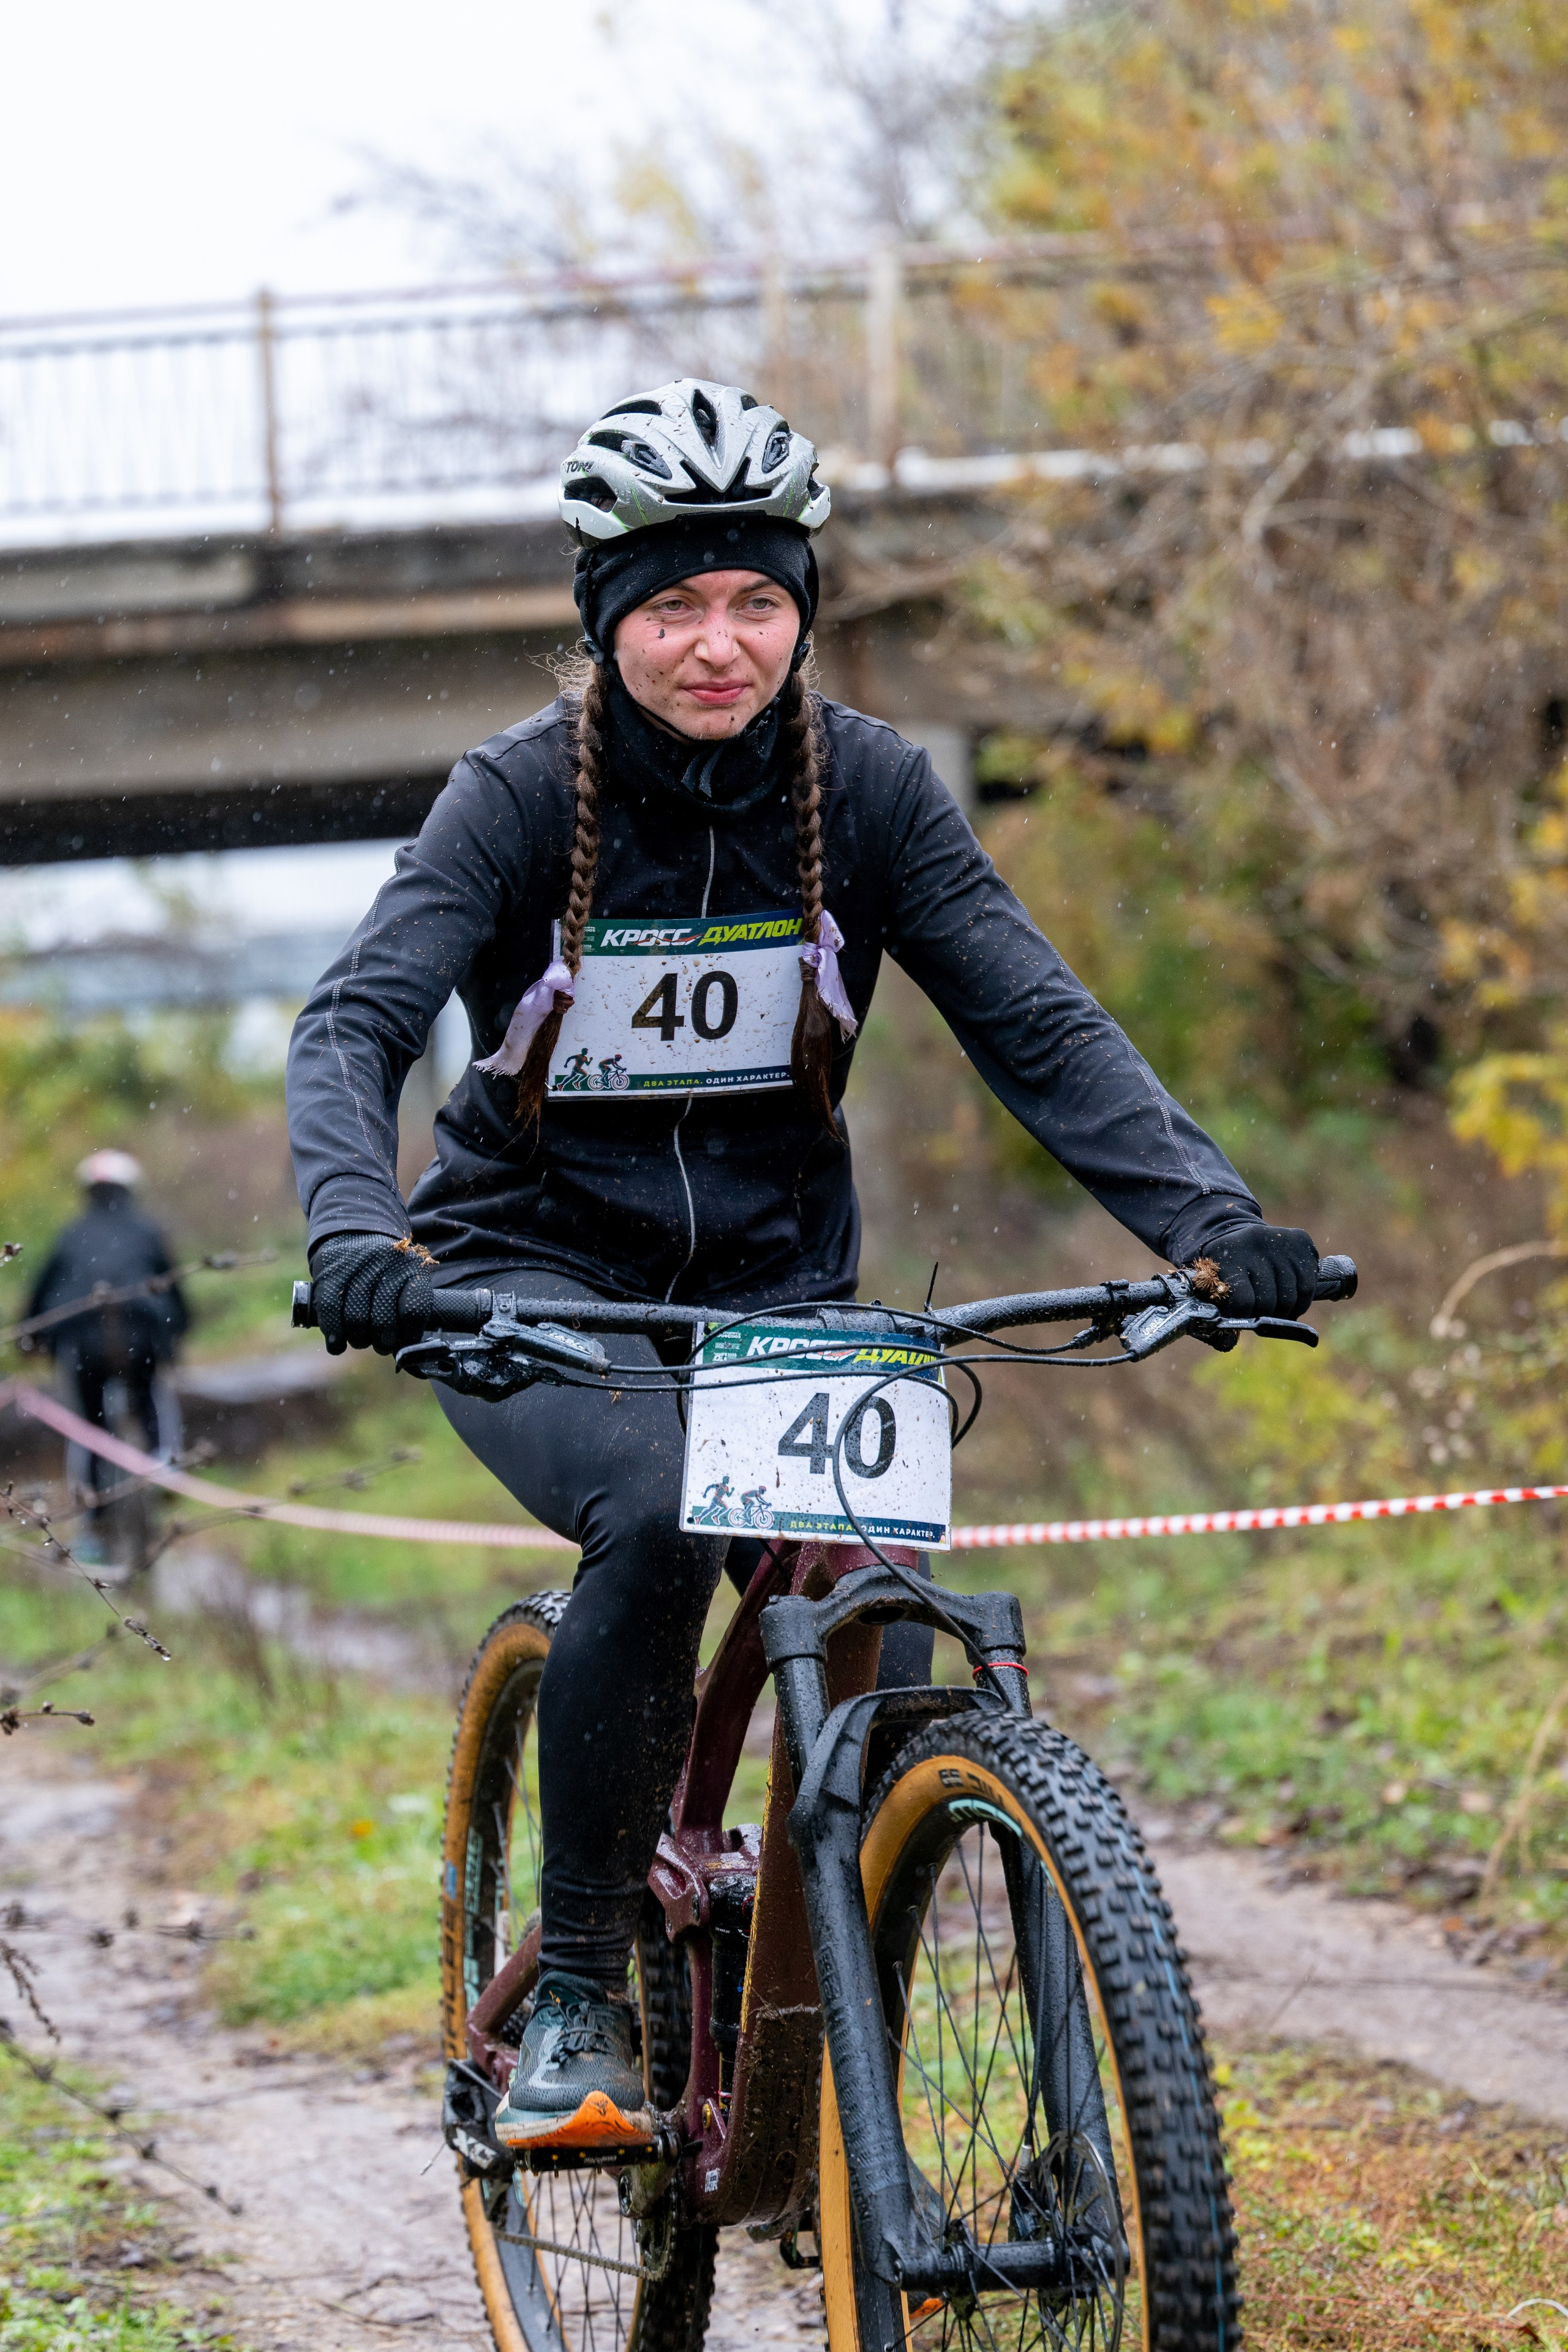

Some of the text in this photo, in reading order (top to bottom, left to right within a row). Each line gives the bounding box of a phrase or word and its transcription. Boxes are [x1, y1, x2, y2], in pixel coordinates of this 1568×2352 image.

[601, 918, 802, 948] КРОСС ДУАТЛОН
[631, 971, 738, 1041] 40
[736, 1072, 790, 1082] ХАРАКТЕР.
[746, 1336, 850, 1361] КРОСС
[778, 1393, 896, 1479] 40
